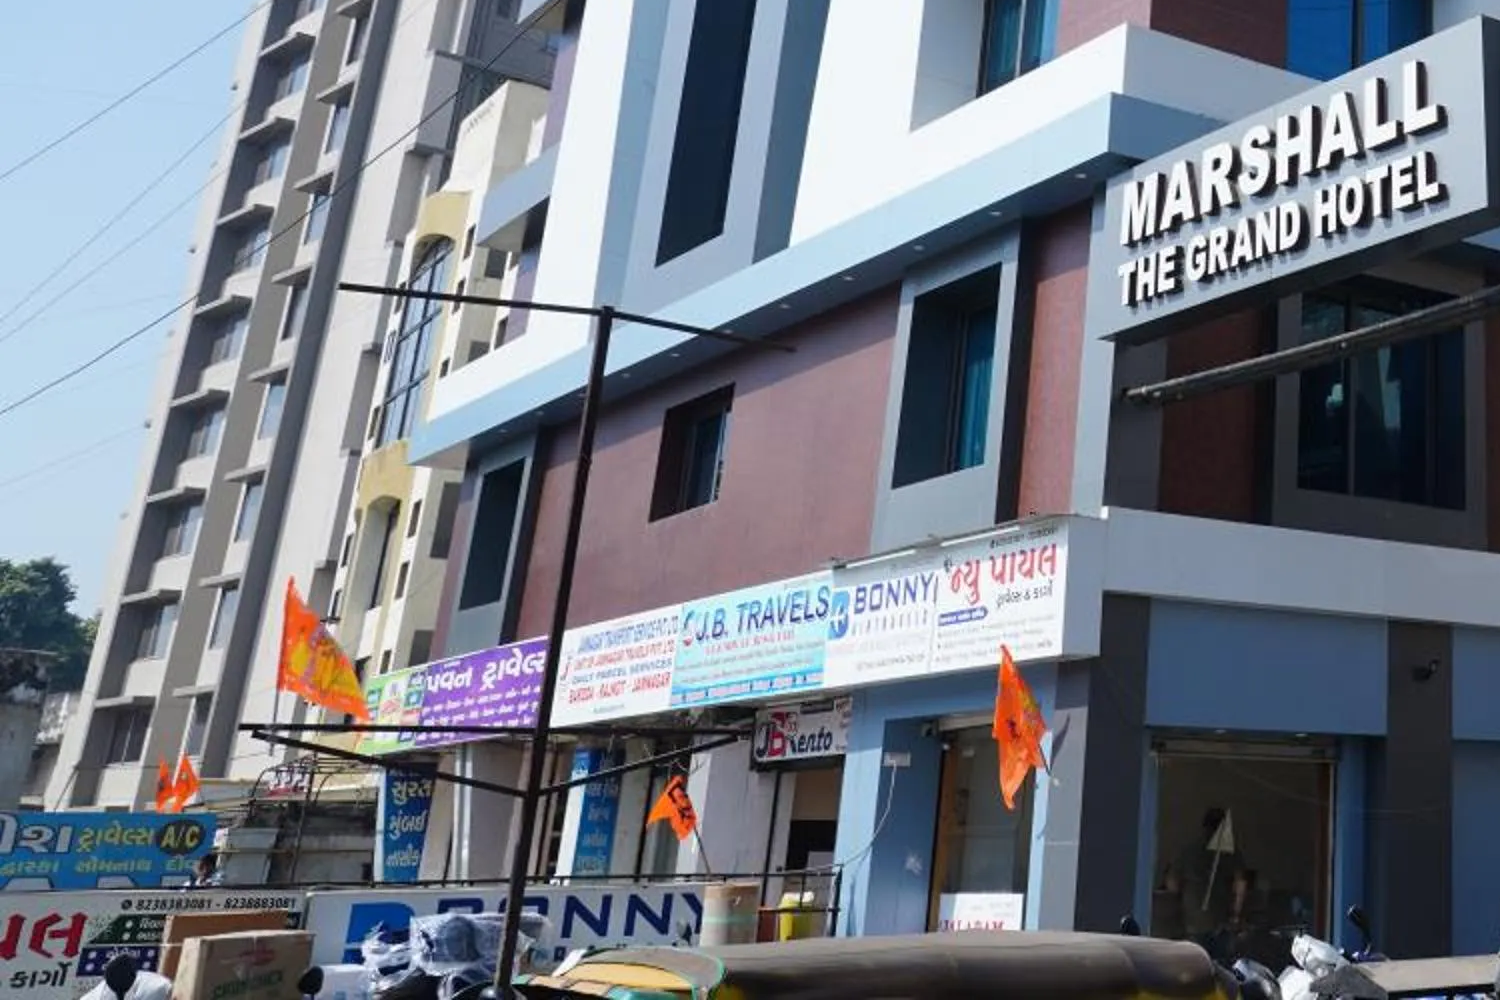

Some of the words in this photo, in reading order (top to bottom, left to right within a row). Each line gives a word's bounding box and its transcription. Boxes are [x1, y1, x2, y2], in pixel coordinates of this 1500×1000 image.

[1119, 59, 1445, 247] MARSHALL
[1117, 242, 1184, 307] THE
[1185, 200, 1304, 283] GRAND
[1313, 151, 1443, 239] HOTEL
[989, 543, 1057, 585] પાયલ
[695, 608, 728, 641] J.B.
[736, 585, 830, 633] TRAVELS
[854, 571, 934, 615] BONNY
[425, 668, 473, 694] પવન
[161, 825, 200, 849] A/C
[437, 892, 704, 939] NNY
